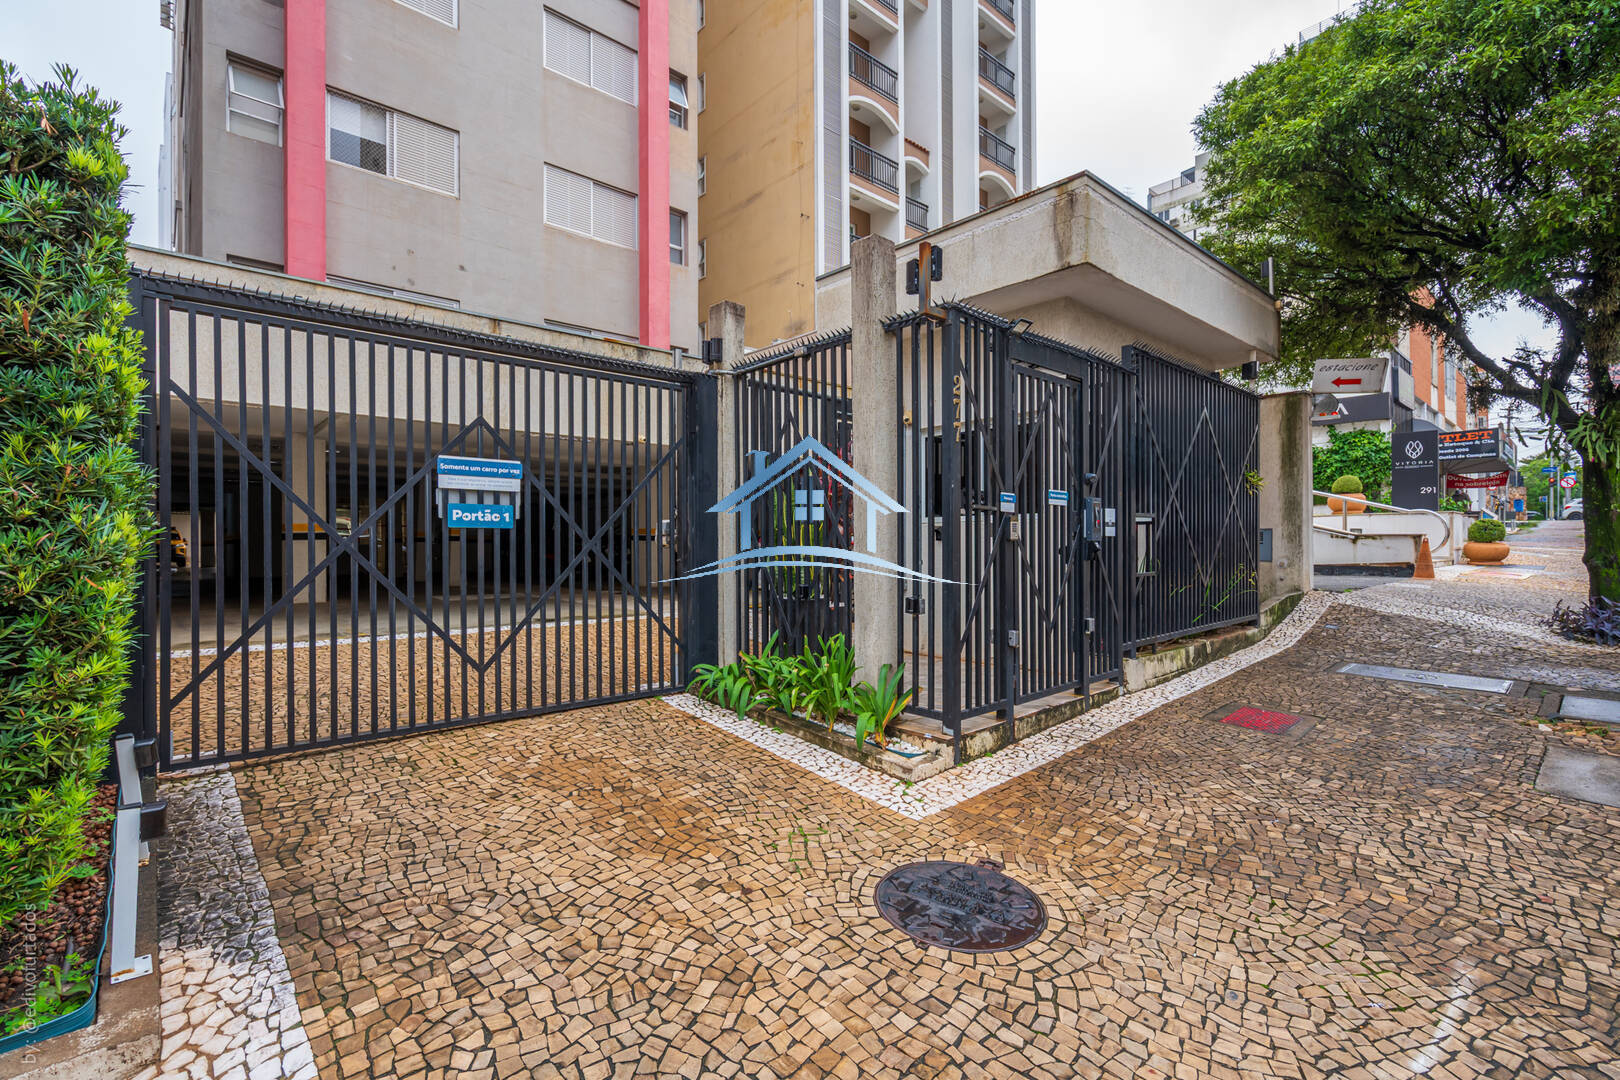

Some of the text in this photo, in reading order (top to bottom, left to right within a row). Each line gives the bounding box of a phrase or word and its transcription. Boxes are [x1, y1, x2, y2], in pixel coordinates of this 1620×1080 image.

[1319, 363, 1379, 373] estacione
[953, 375, 962, 443] 277
[440, 463, 469, 472] Somente
[1420, 486, 1437, 494] 291
[452, 509, 510, 522] Portão 1
